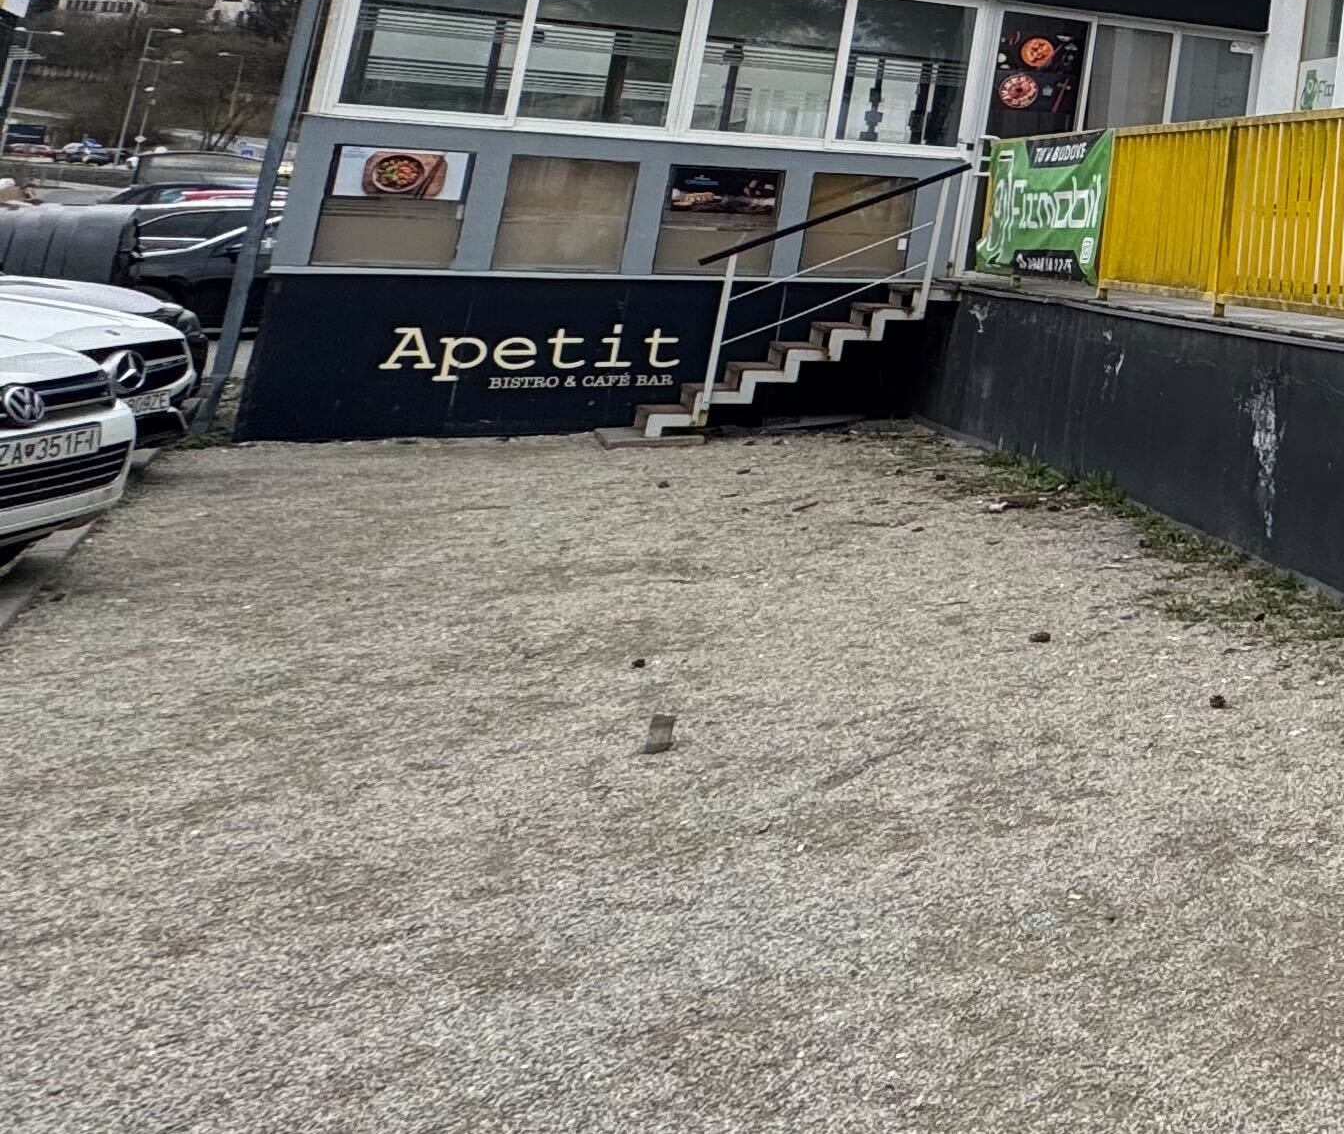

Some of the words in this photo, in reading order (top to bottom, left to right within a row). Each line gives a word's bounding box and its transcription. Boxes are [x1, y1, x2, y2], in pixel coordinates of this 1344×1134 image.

[378, 324, 680, 382] Apetit
[487, 375, 560, 389] BISTRO
[564, 375, 577, 387] &
[582, 372, 631, 387] CAFÉ
[635, 374, 673, 386] BAR
